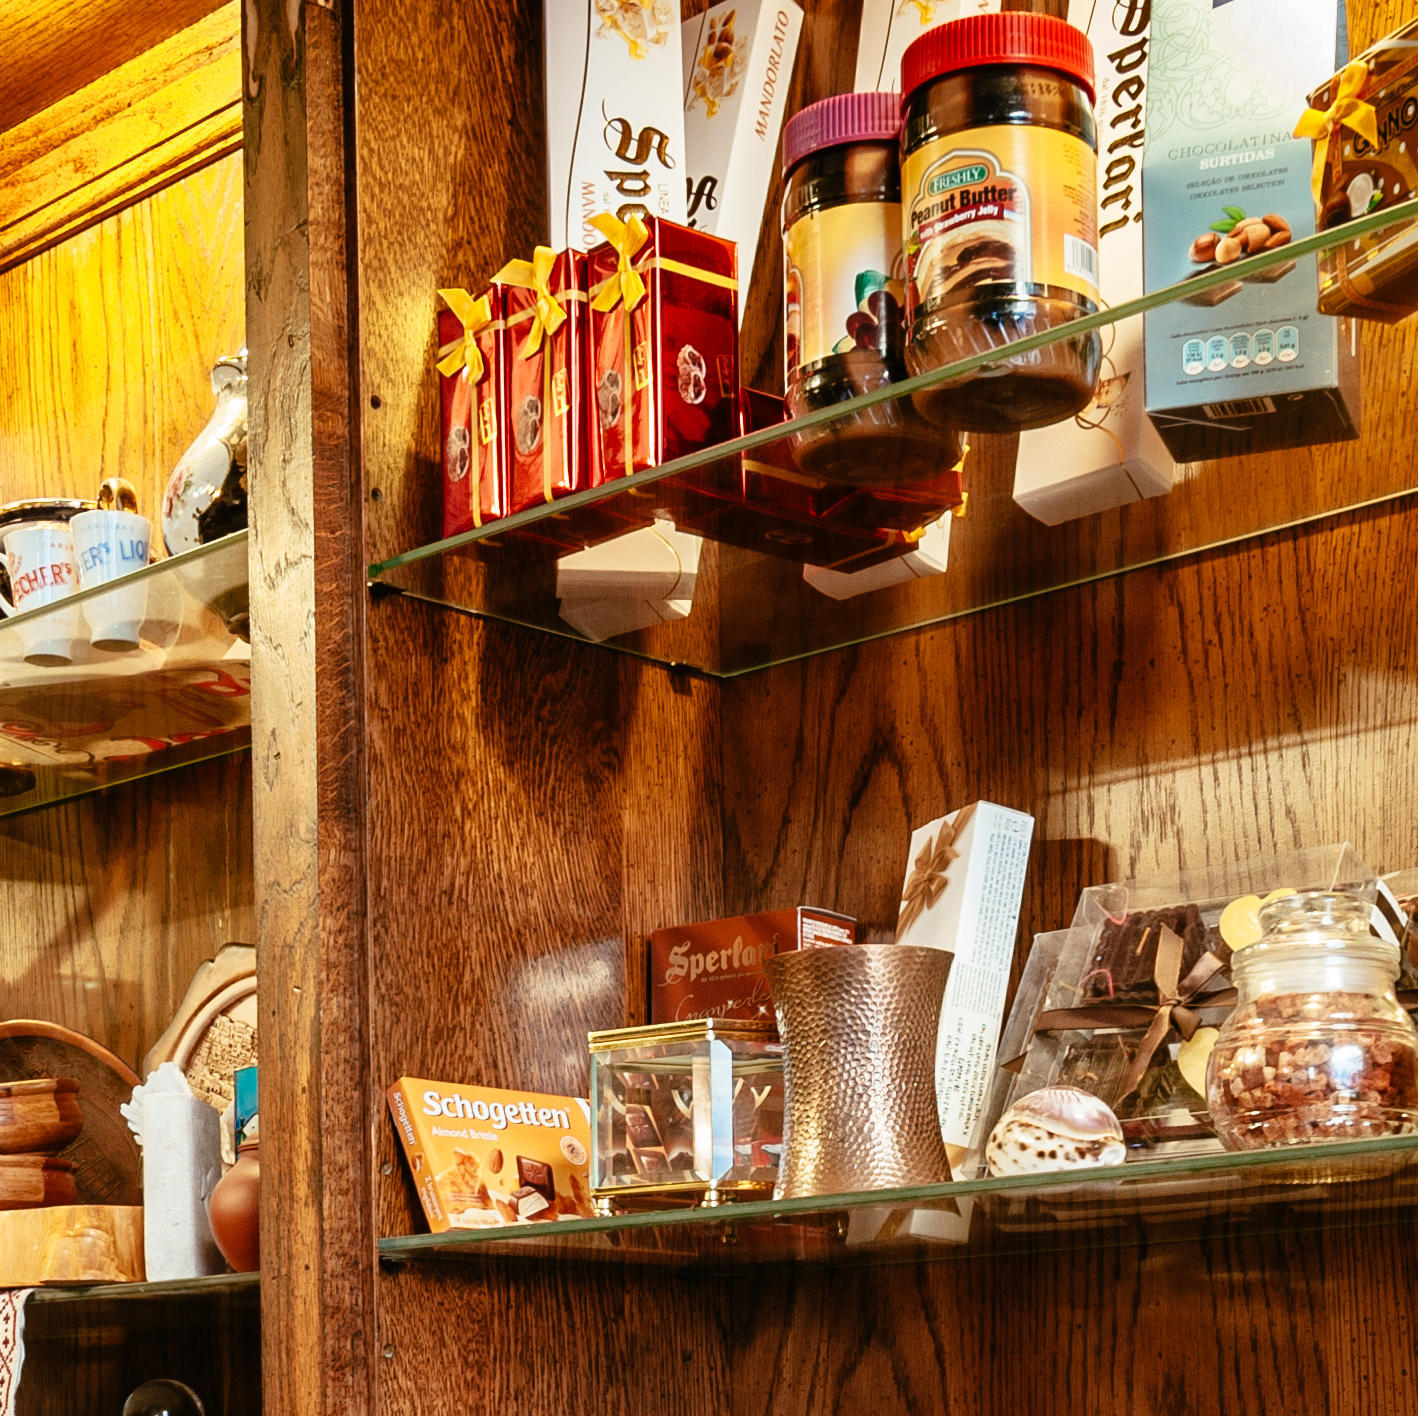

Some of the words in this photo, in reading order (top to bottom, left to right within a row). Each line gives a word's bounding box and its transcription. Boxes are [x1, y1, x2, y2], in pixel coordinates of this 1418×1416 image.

[755, 10, 790, 141] MANDORLATO
[1167, 131, 1293, 161] CHOCOLATINA
[1199, 147, 1275, 170] SURTIDAS
[933, 166, 981, 190] FRESHLY
[911, 192, 957, 229] Peanut
[959, 185, 1017, 208] Butter
[934, 207, 976, 234] Strawberry
[393, 1091, 417, 1146] Schogetten
[422, 1090, 571, 1130] Schogetten
[432, 1125, 469, 1139] Almond
[470, 1128, 499, 1142] Brittle
